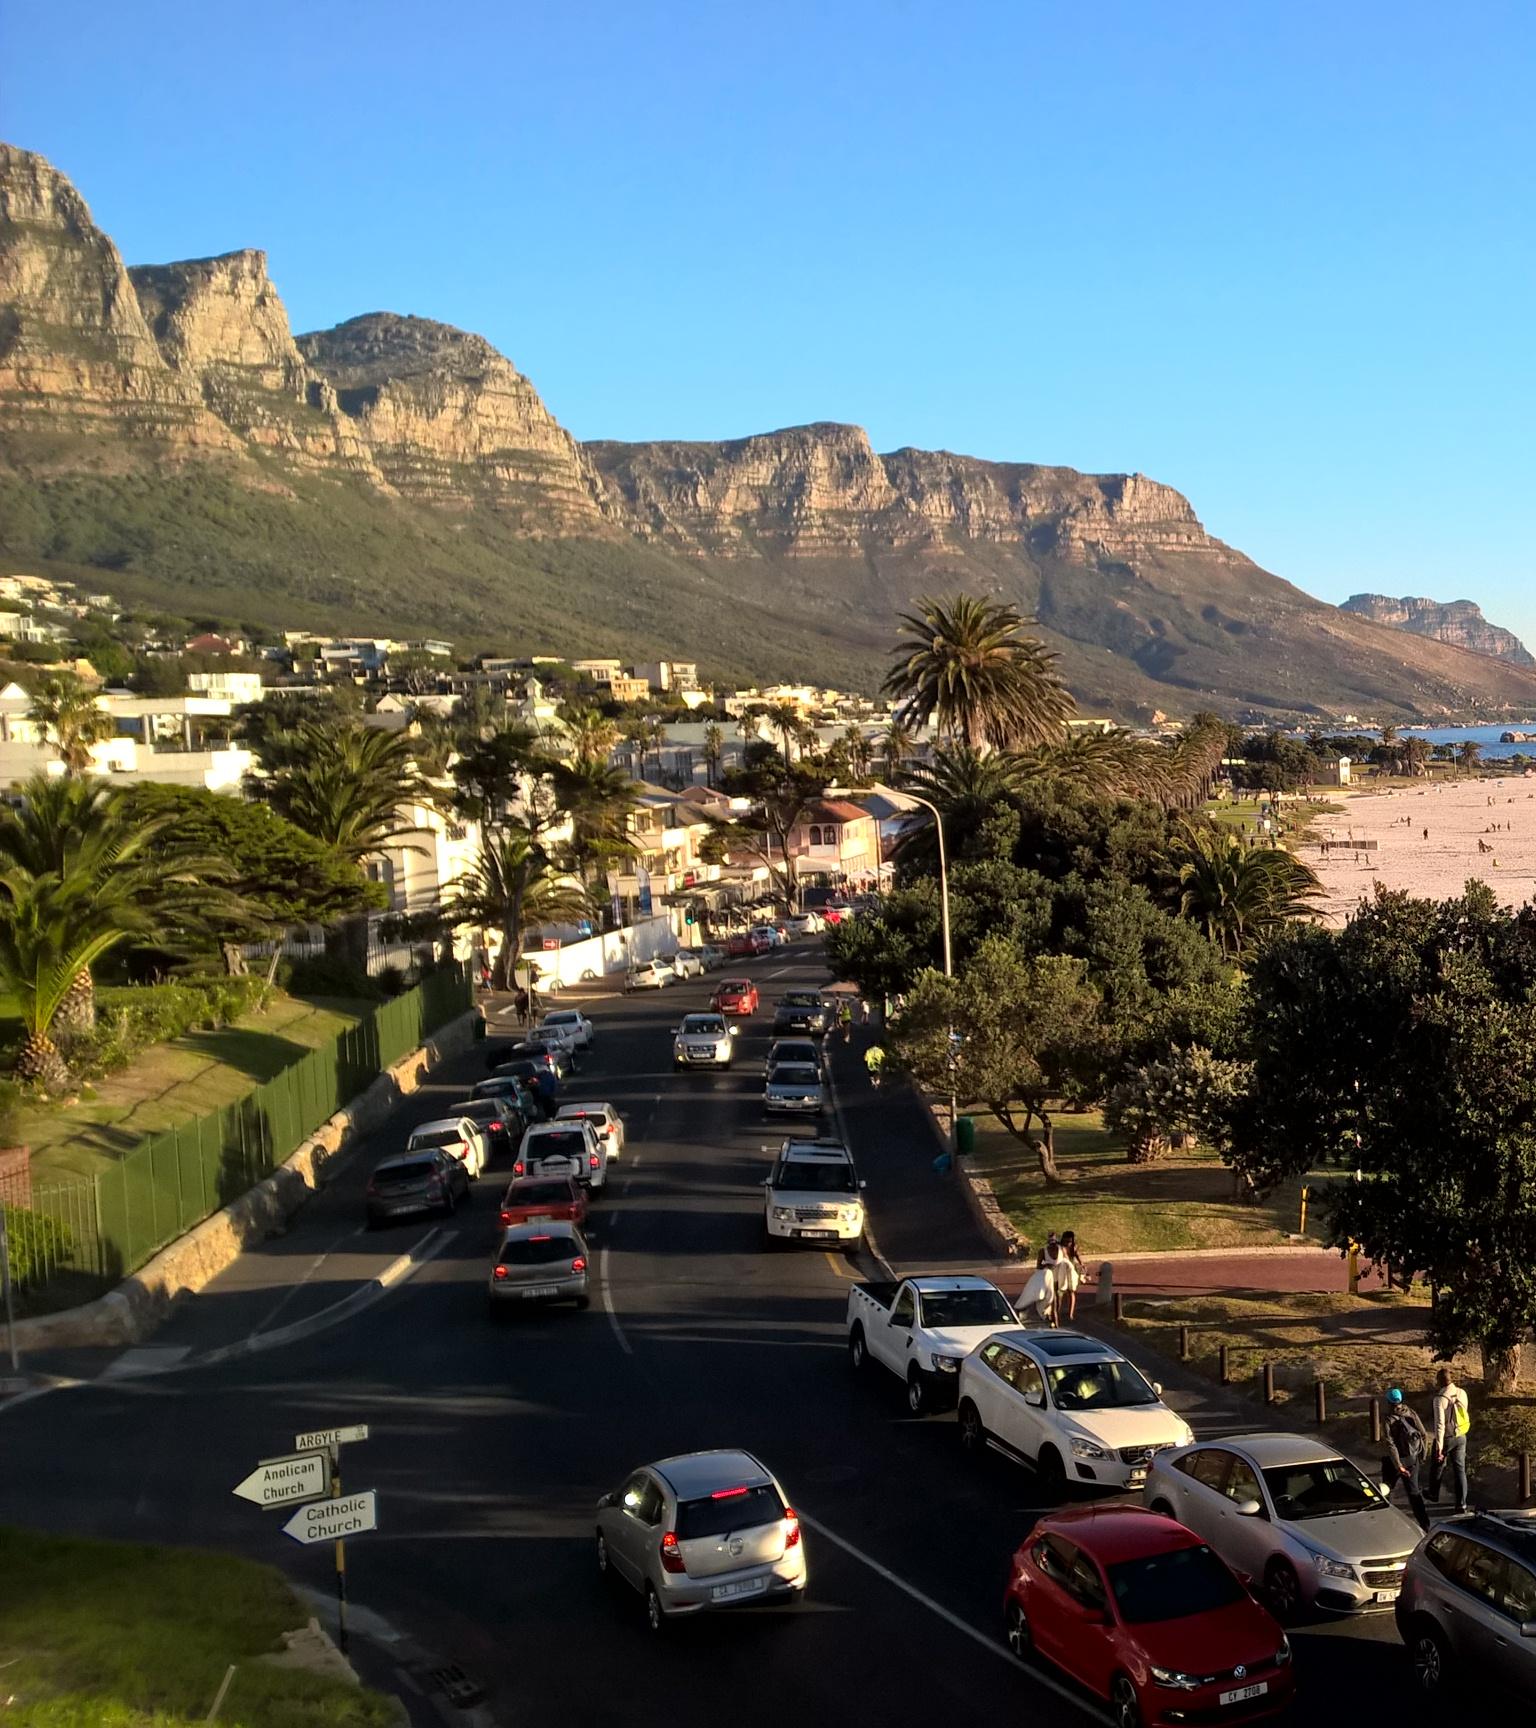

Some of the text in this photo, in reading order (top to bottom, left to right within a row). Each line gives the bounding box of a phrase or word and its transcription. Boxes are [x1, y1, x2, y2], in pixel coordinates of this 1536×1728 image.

[299, 1430, 341, 1448] ARGYLE
[263, 1481, 304, 1500] Church
[307, 1499, 366, 1521] Catholic
[307, 1517, 362, 1539] Church
